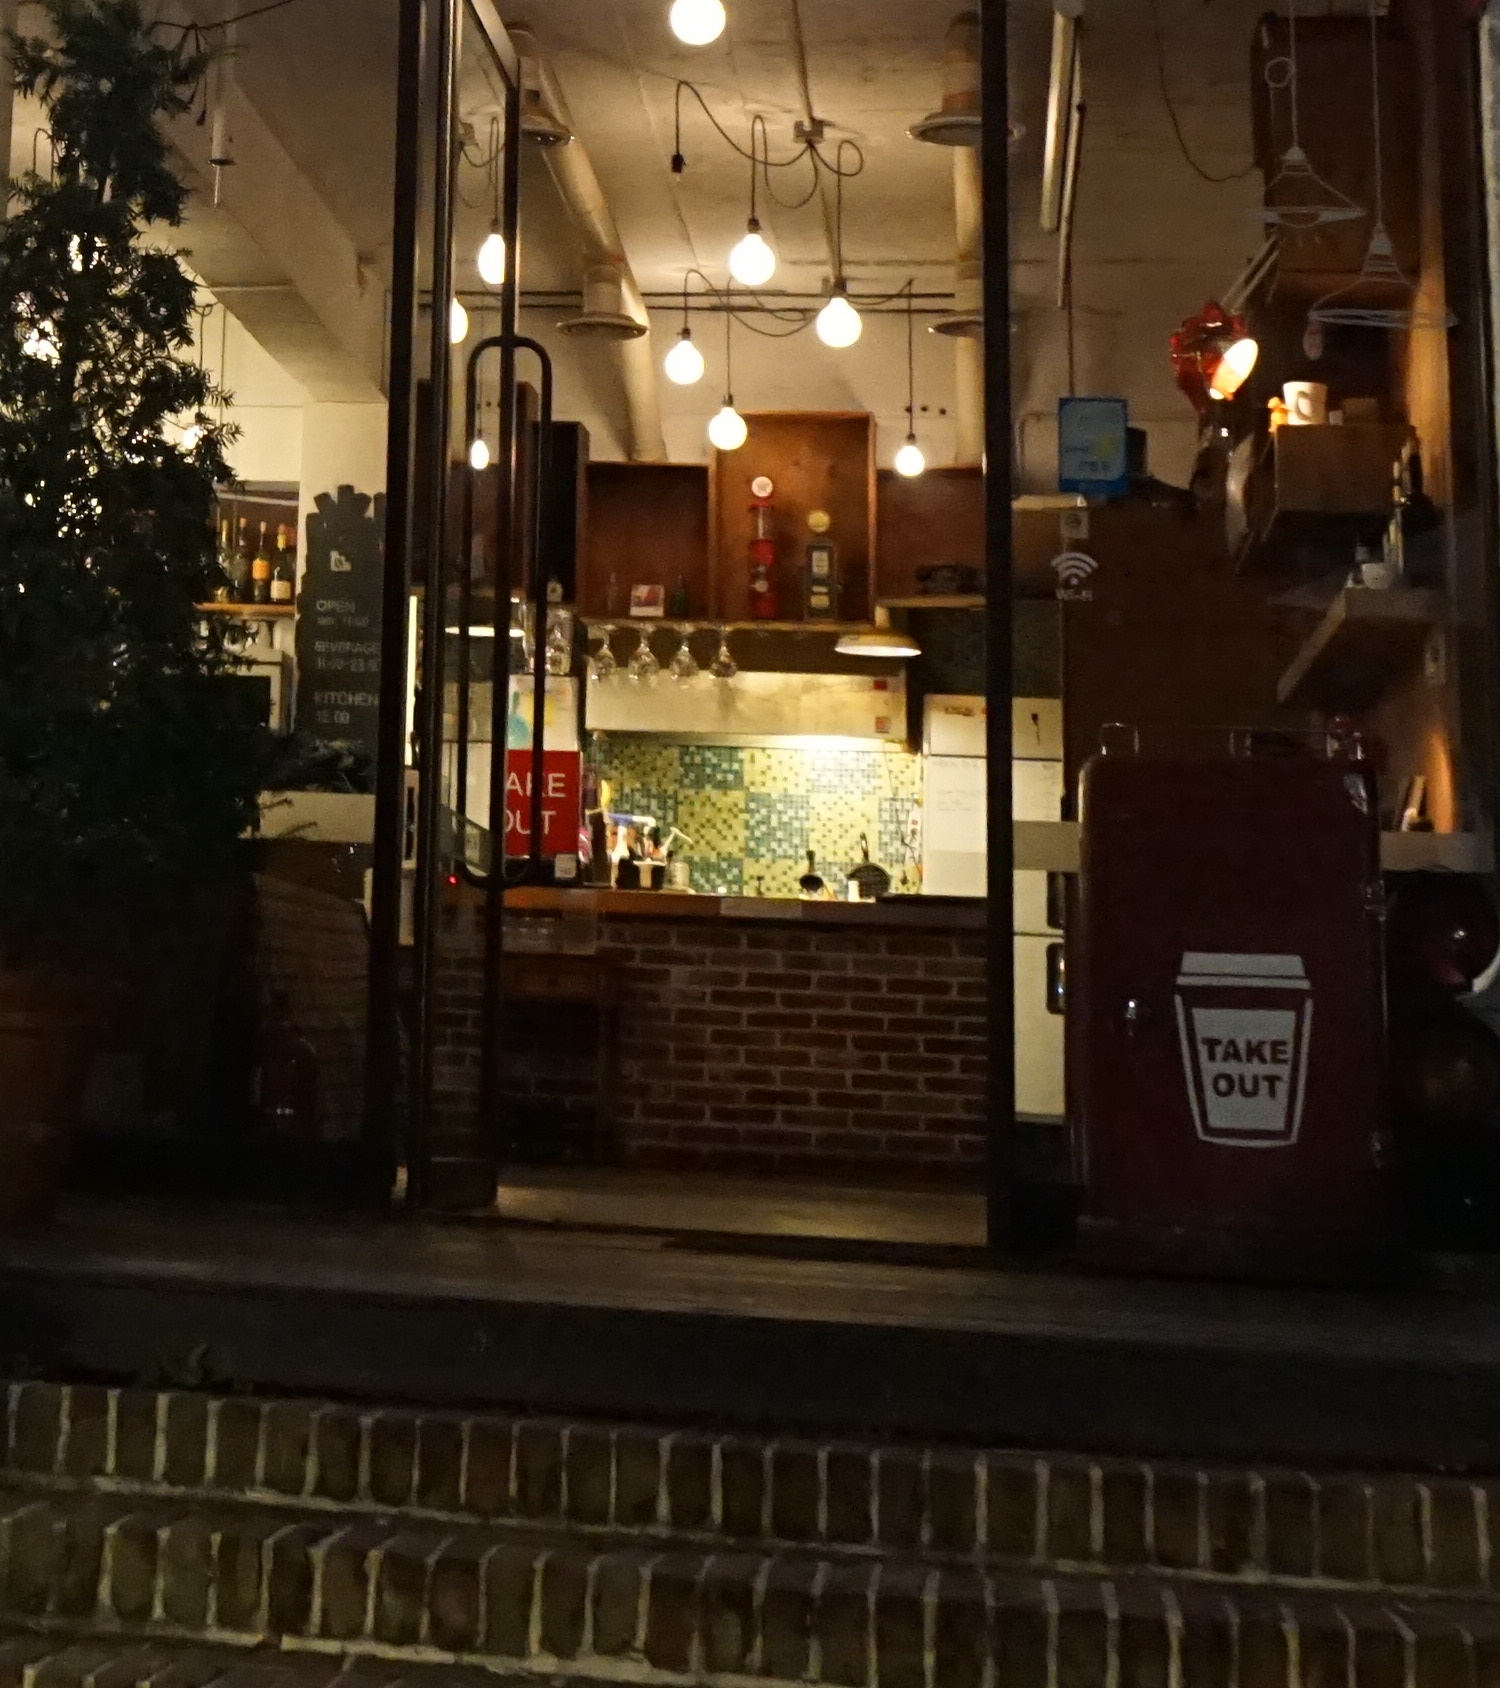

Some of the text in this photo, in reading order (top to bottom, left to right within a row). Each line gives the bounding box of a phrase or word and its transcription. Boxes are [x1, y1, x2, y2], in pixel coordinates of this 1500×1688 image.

[505, 771, 567, 798] AKE
[1202, 1037, 1289, 1065] TAKE
[1212, 1072, 1283, 1099] OUT
